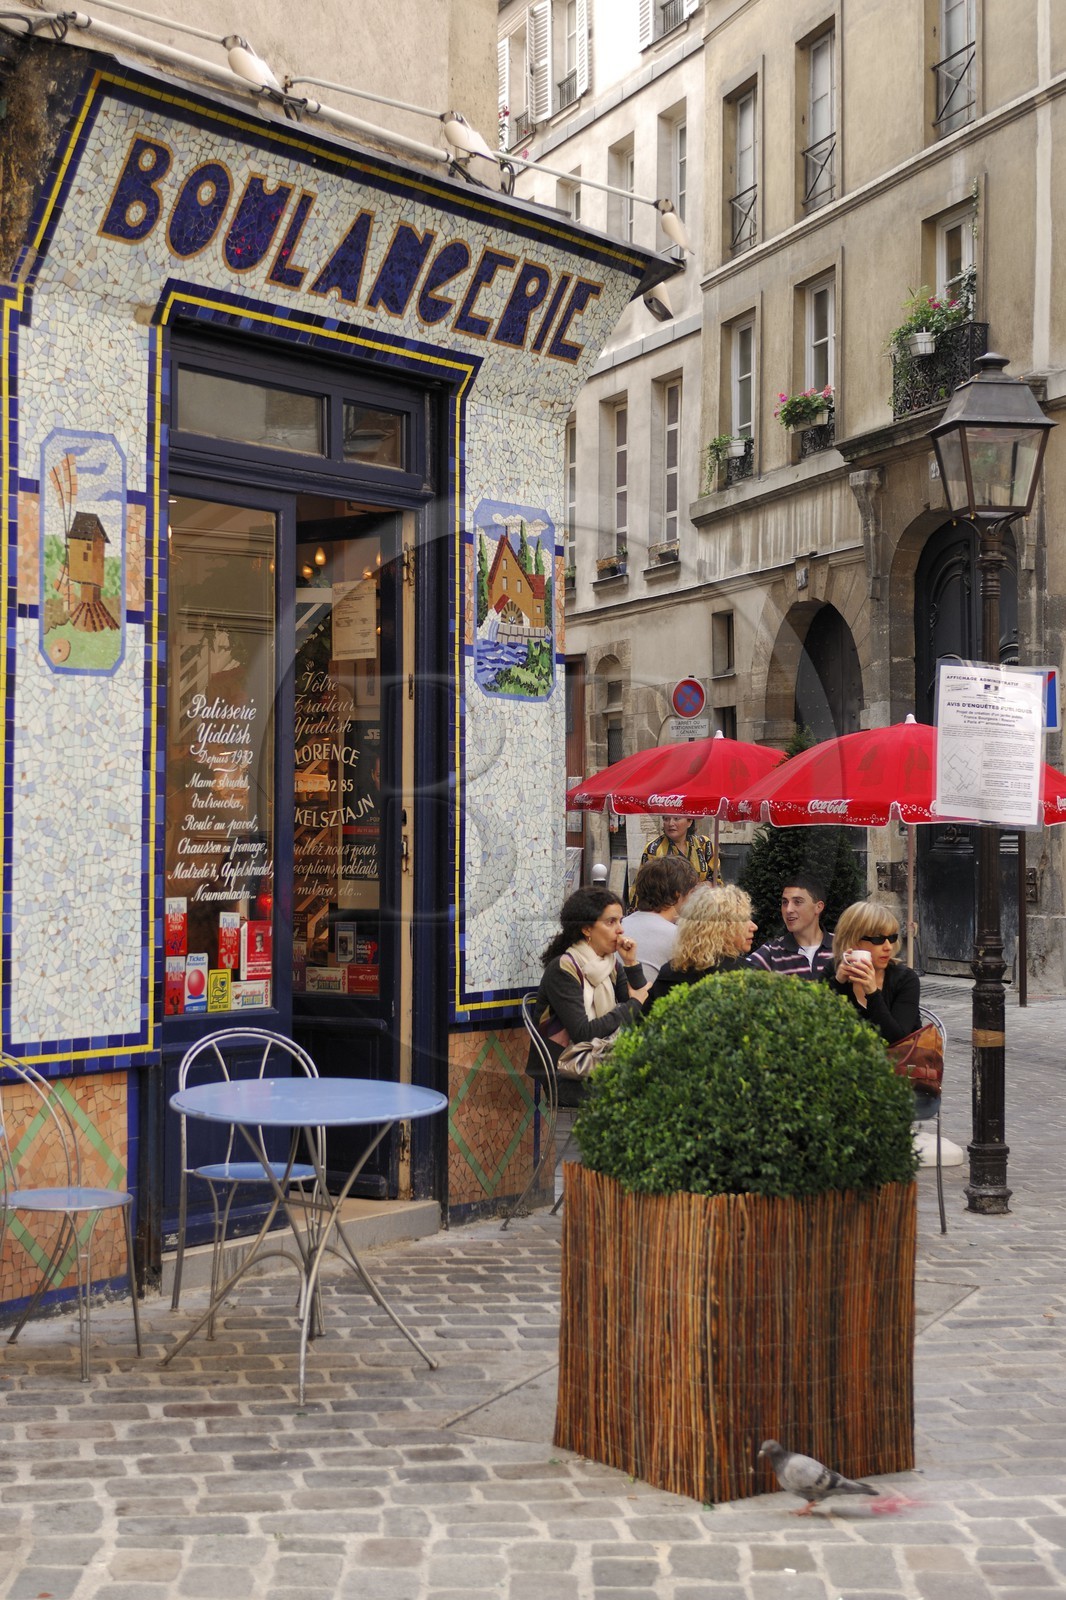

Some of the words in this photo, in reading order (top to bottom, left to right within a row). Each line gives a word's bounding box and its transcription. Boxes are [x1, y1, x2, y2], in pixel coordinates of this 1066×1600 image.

[97, 131, 605, 366] BOULANGERIE
[302, 671, 339, 692] Votre
[187, 694, 257, 720] Patisserie
[295, 694, 355, 714] Traiteur
[190, 722, 251, 754] Yiddish
[295, 715, 353, 743] Yiddish
[198, 749, 229, 769] Depuis
[185, 772, 217, 789] Mame
[341, 779, 354, 792] 85
[647, 794, 687, 807] Coca-Cola
[807, 799, 853, 814] Coca-Cola
[294, 794, 375, 828] KELSZTAJN
[182, 814, 215, 831] Roulé
[230, 837, 268, 860] fromage,
